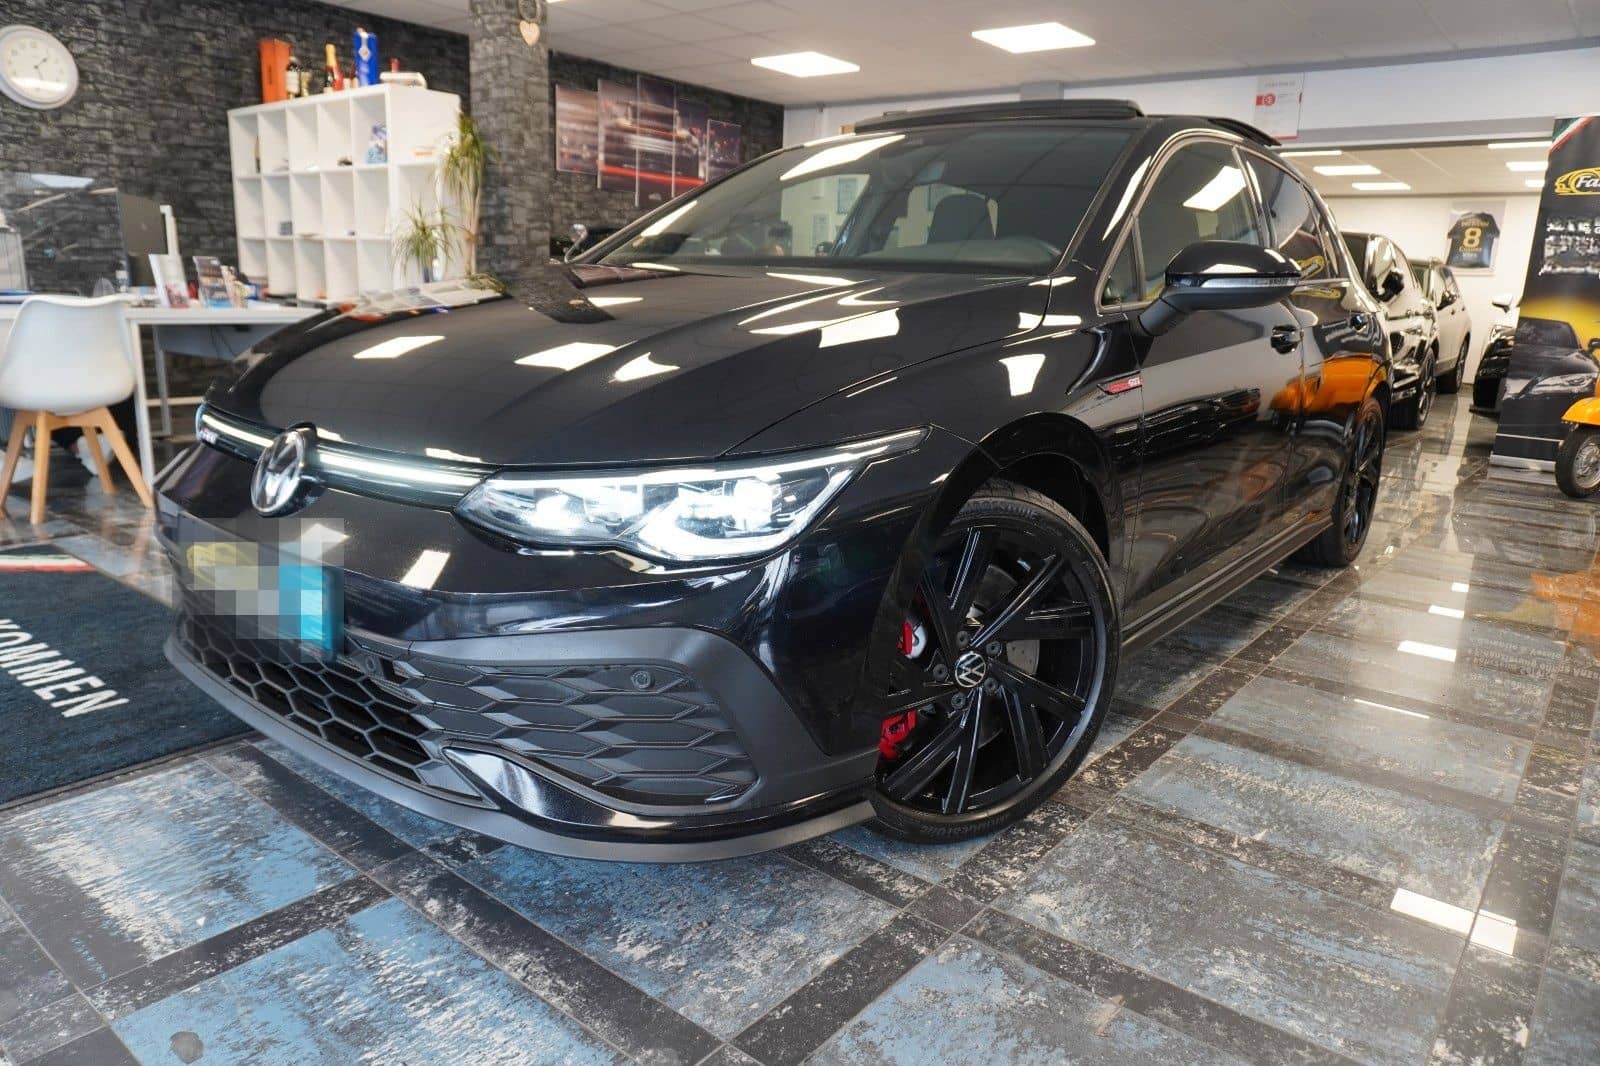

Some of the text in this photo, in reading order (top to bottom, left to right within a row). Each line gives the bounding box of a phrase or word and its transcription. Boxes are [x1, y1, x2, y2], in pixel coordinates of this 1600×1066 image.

[1576, 175, 1600, 188] Fa
[1463, 227, 1482, 247] 8
[0, 618, 130, 719] OMMEN
